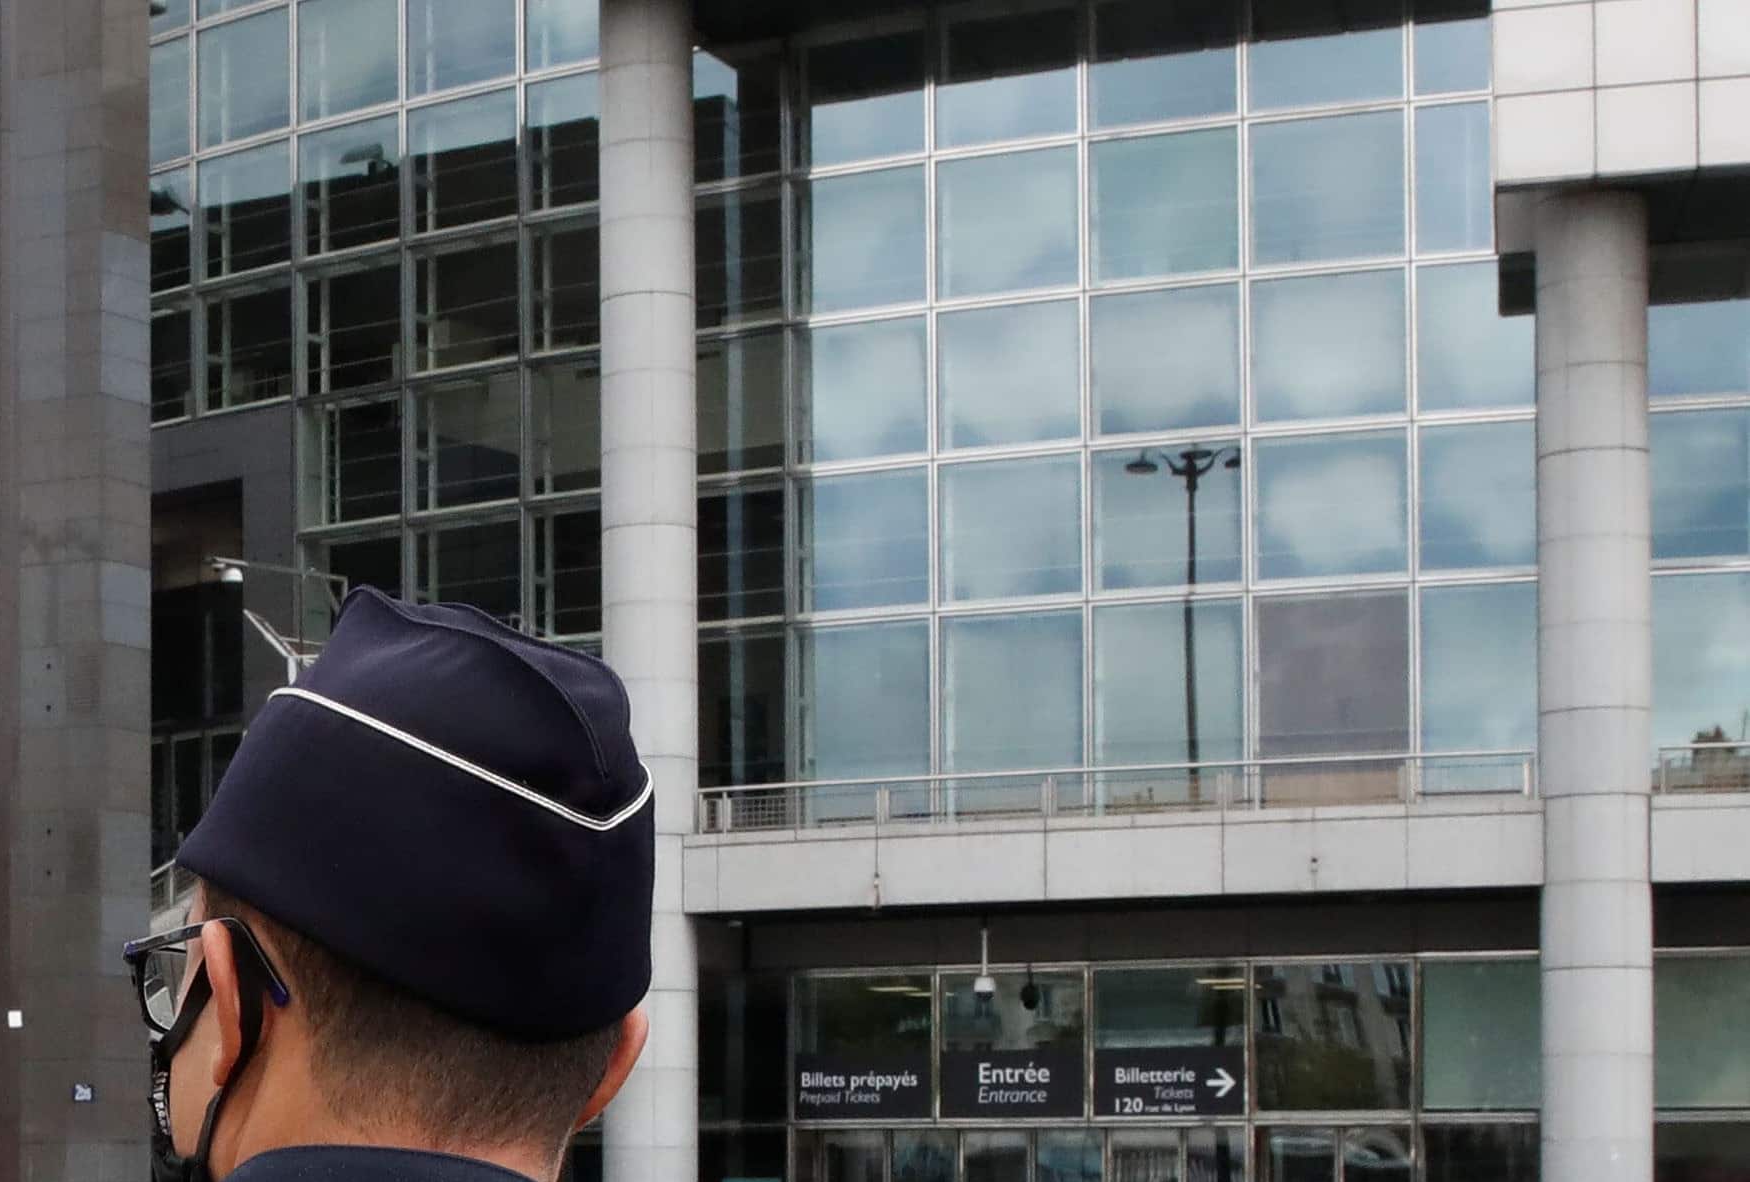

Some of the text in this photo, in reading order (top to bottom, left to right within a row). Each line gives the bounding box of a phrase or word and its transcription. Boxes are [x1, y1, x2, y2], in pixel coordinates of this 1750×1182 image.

[801, 1069, 918, 1091] Billets prépayés
[978, 1061, 1051, 1084] Entrée
[1114, 1066, 1196, 1084] Billetterie
[799, 1091, 841, 1106] Prepaid
[977, 1086, 1048, 1103] Entrance
[1114, 1097, 1143, 1113] 120
